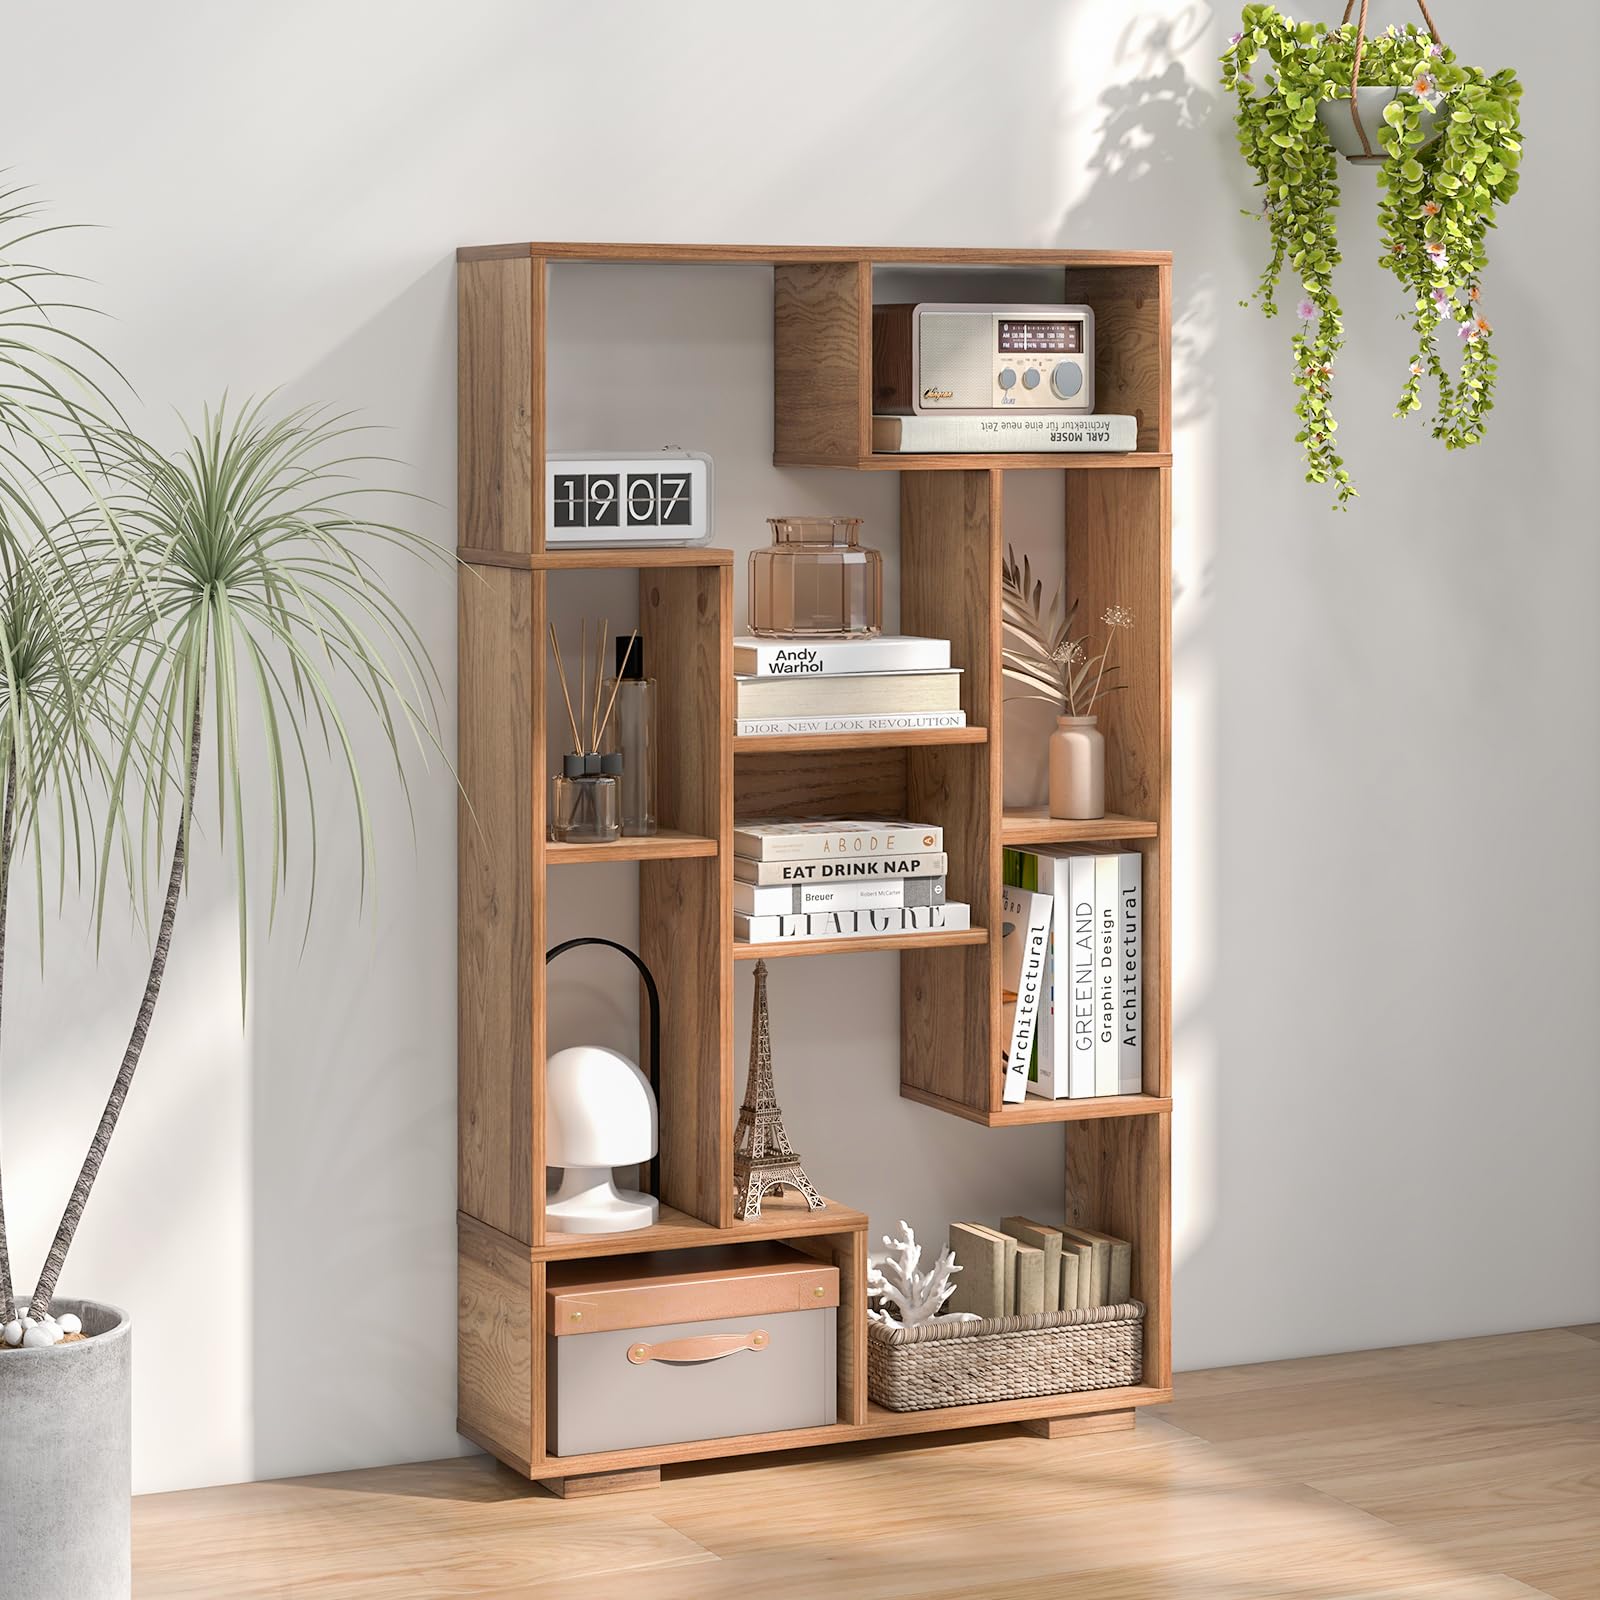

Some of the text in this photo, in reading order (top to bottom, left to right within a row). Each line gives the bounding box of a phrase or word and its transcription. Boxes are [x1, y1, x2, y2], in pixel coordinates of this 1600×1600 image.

[981, 422, 999, 432] Zeit
[1025, 421, 1044, 431] eine
[1046, 421, 1059, 431] für
[1061, 421, 1110, 431] Architektur
[1050, 432, 1110, 442] CARL MOSER
[563, 479, 686, 521] 1907
[776, 648, 817, 663] Andy
[769, 660, 823, 674] Warhol
[787, 722, 820, 732] NEW
[825, 720, 864, 731] LOOK
[869, 716, 960, 729] REVOLUTION
[823, 835, 896, 853] ABODE
[783, 860, 921, 880] EAT DRINK NAP
[805, 892, 834, 902] Breuer
[1122, 886, 1137, 1047] Architectural
[1075, 902, 1093, 1051] GREENLAND
[1101, 909, 1114, 1043] Graphic Design
[1012, 925, 1045, 1075] Architectural
